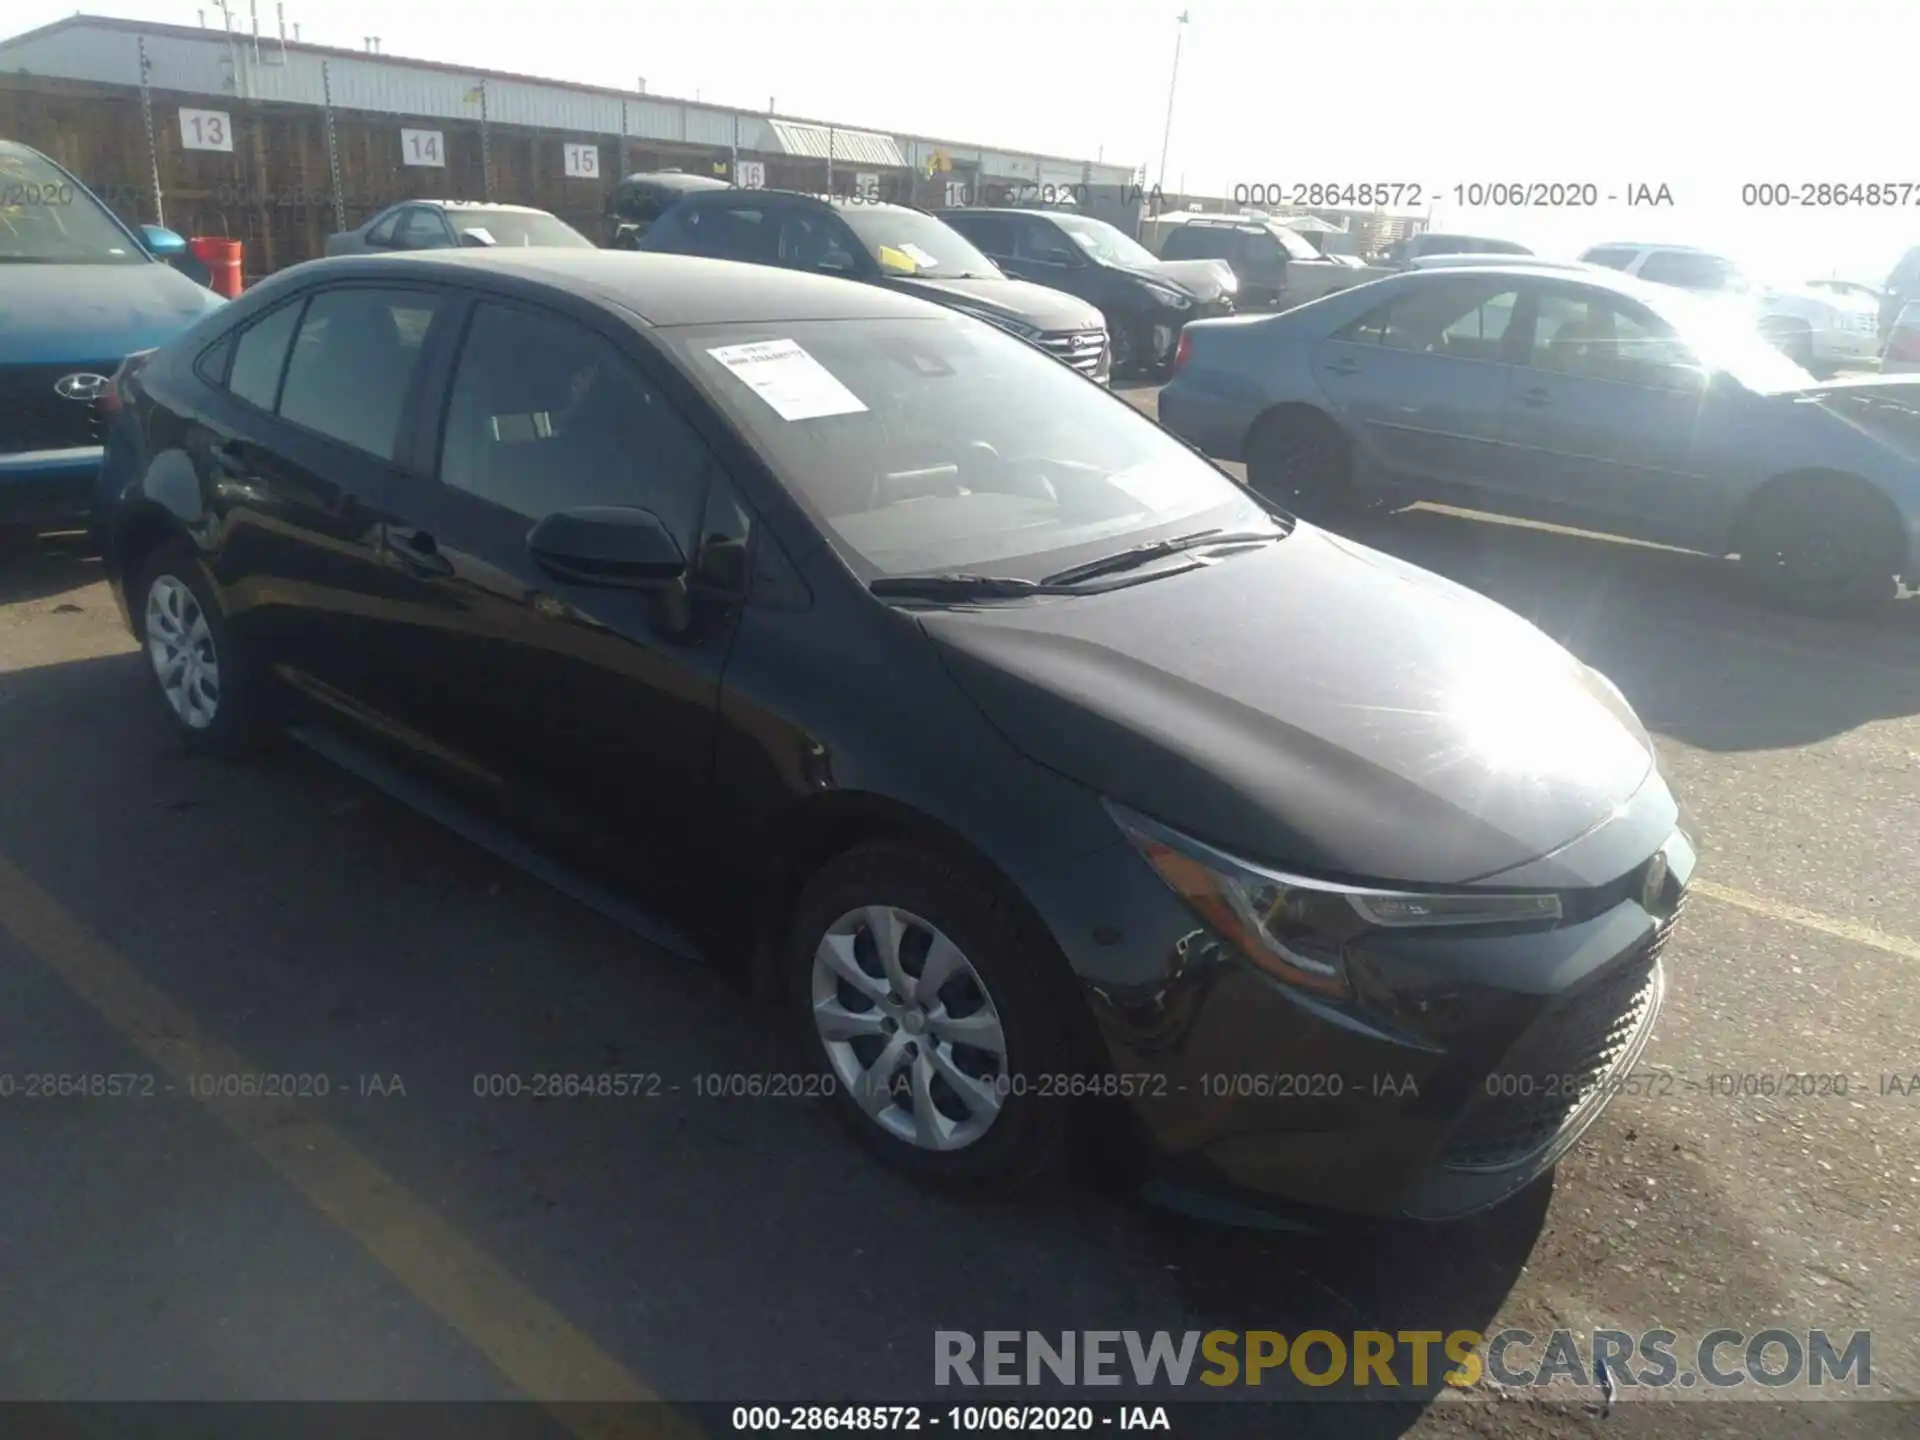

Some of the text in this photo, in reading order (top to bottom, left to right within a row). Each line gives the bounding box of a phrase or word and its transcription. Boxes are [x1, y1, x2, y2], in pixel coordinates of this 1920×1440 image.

[191, 116, 224, 145] 13
[409, 135, 437, 161] 14
[571, 148, 594, 172] 15
